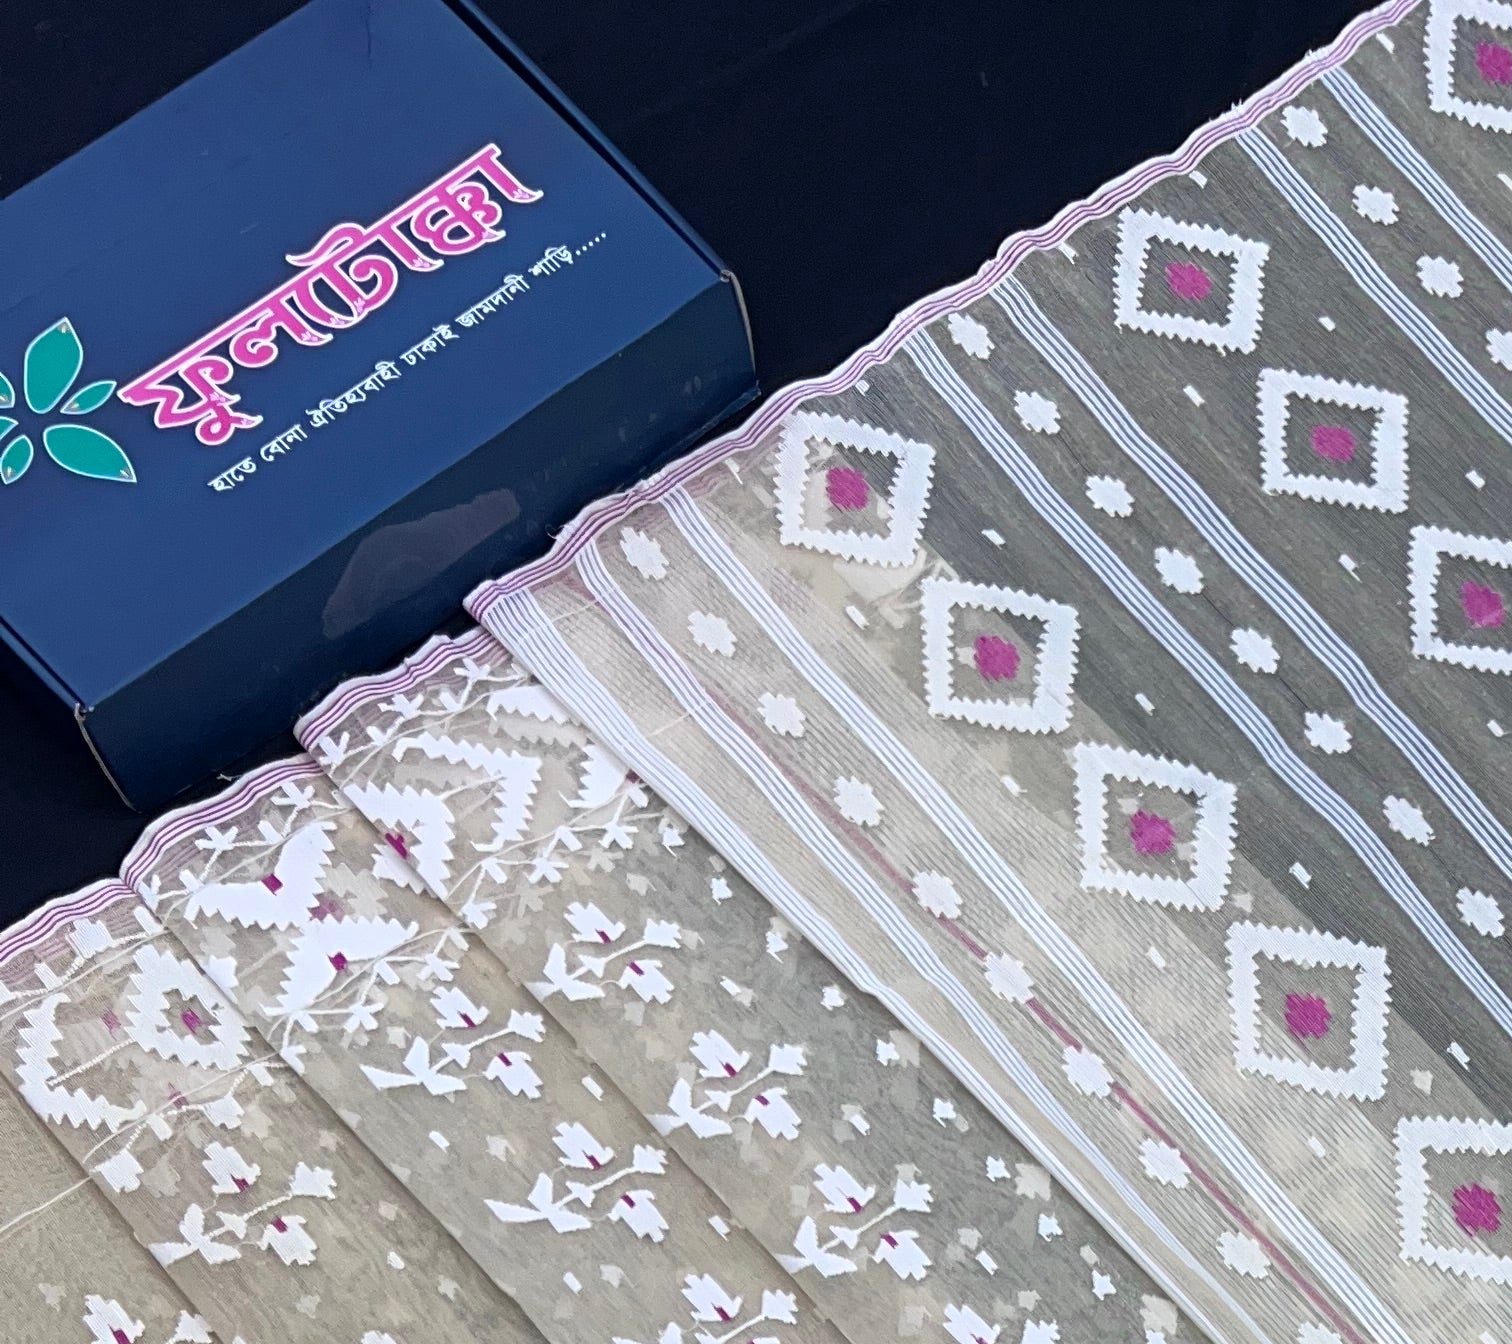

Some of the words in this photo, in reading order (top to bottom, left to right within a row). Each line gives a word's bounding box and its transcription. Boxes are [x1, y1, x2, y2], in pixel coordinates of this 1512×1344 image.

[116, 142, 545, 446] ফুলটোক্কা
[207, 456, 257, 492] হাতে
[259, 423, 308, 462] বোনা
[305, 360, 402, 428] ঐতিহ্যবাহী
[399, 324, 460, 366] ঢাকাই
[455, 274, 530, 327] জামদানী
